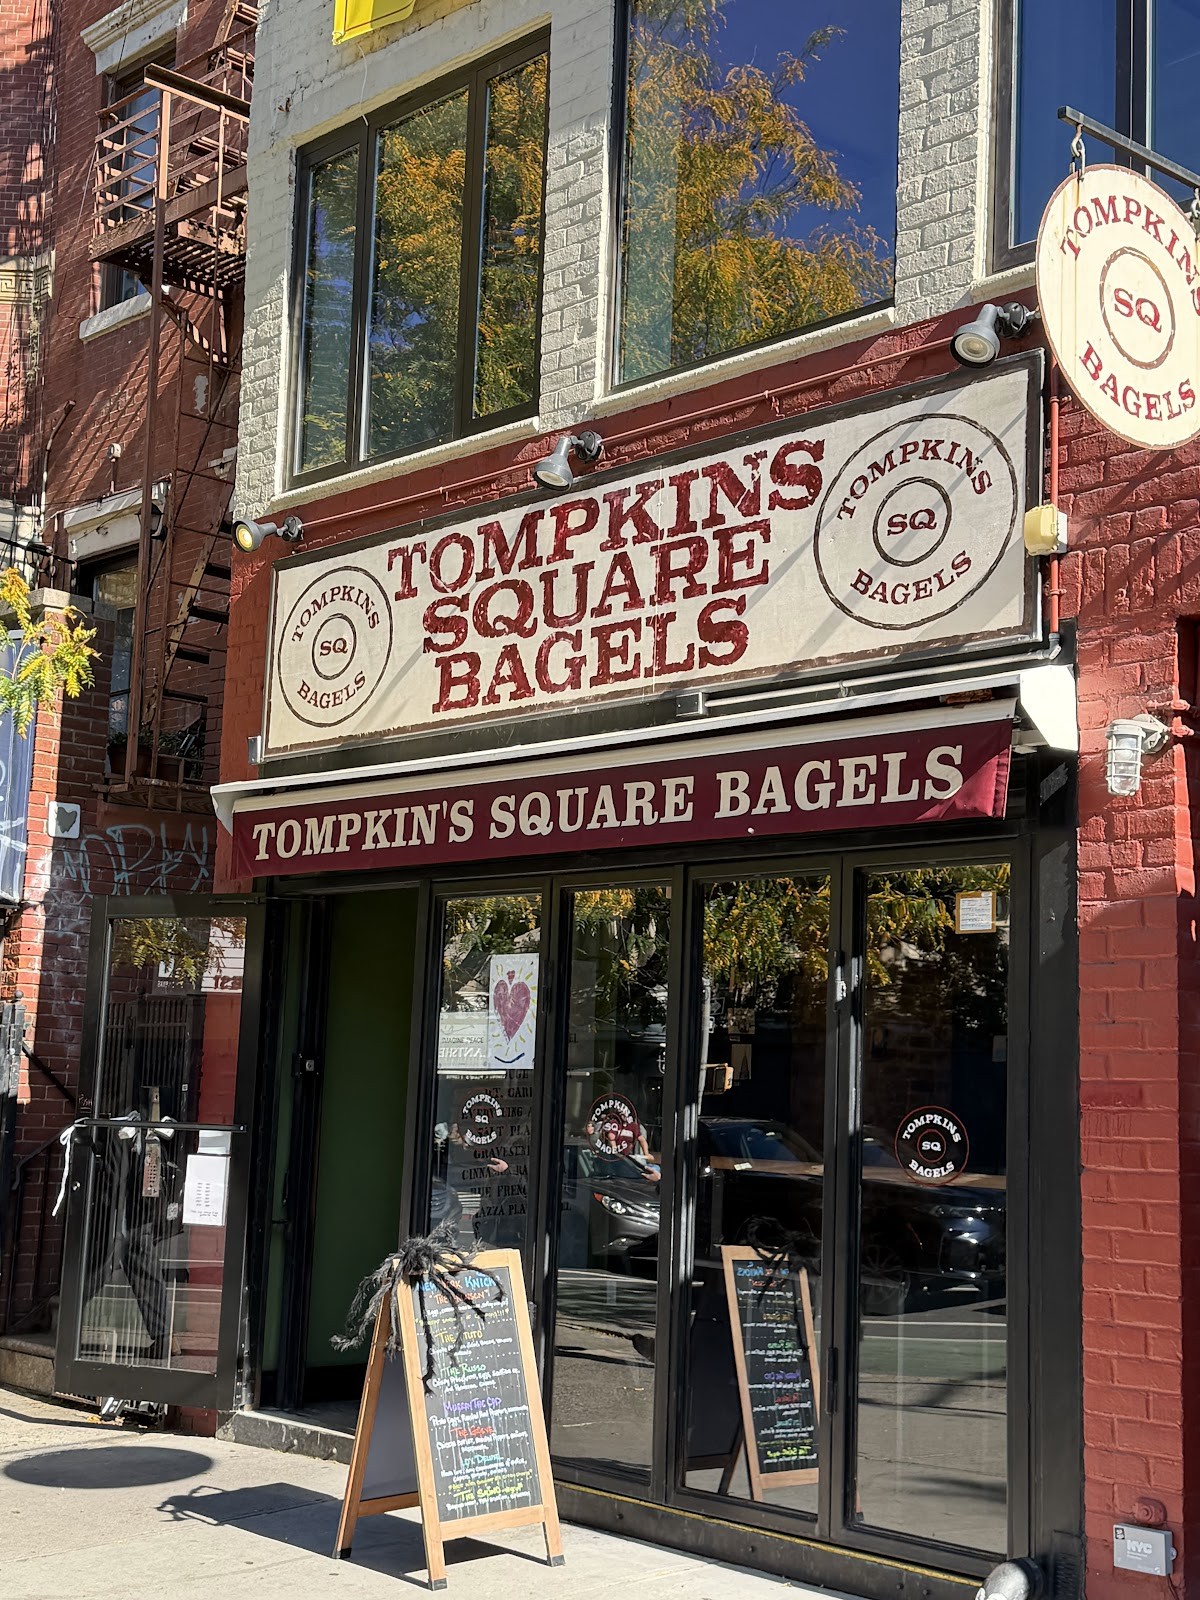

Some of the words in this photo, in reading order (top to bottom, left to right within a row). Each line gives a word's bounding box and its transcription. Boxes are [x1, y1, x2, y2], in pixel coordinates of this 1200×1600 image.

[1113, 288, 1162, 333] SQ
[1079, 340, 1196, 422] BAGELS
[837, 439, 993, 520] TOMPKINS
[388, 439, 825, 600] TOMPKINS
[887, 508, 937, 536] SQ
[423, 518, 771, 653] SQUARE
[850, 550, 972, 605] BAGELS
[291, 585, 380, 642] TOMPKINS
[319, 638, 349, 656] SQ
[432, 596, 749, 713] BAGELS
[297, 671, 367, 709] BAGELS
[252, 800, 475, 861] TOMPKIN'S
[488, 776, 696, 840] SQUARE
[714, 745, 964, 819] BAGELS
[463, 1094, 503, 1116] TOMPKINS
[475, 1115, 489, 1124] SQ
[591, 1099, 634, 1123] TOMPKINS
[466, 1129, 498, 1144] BAGELS
[603, 1122, 619, 1132] SQ
[902, 1113, 962, 1143] TOMPKINS
[595, 1139, 628, 1154] BAGELS
[921, 1140, 942, 1152] SQ
[908, 1159, 955, 1178] BAGELS
[1126, 1540, 1152, 1554] NYC
